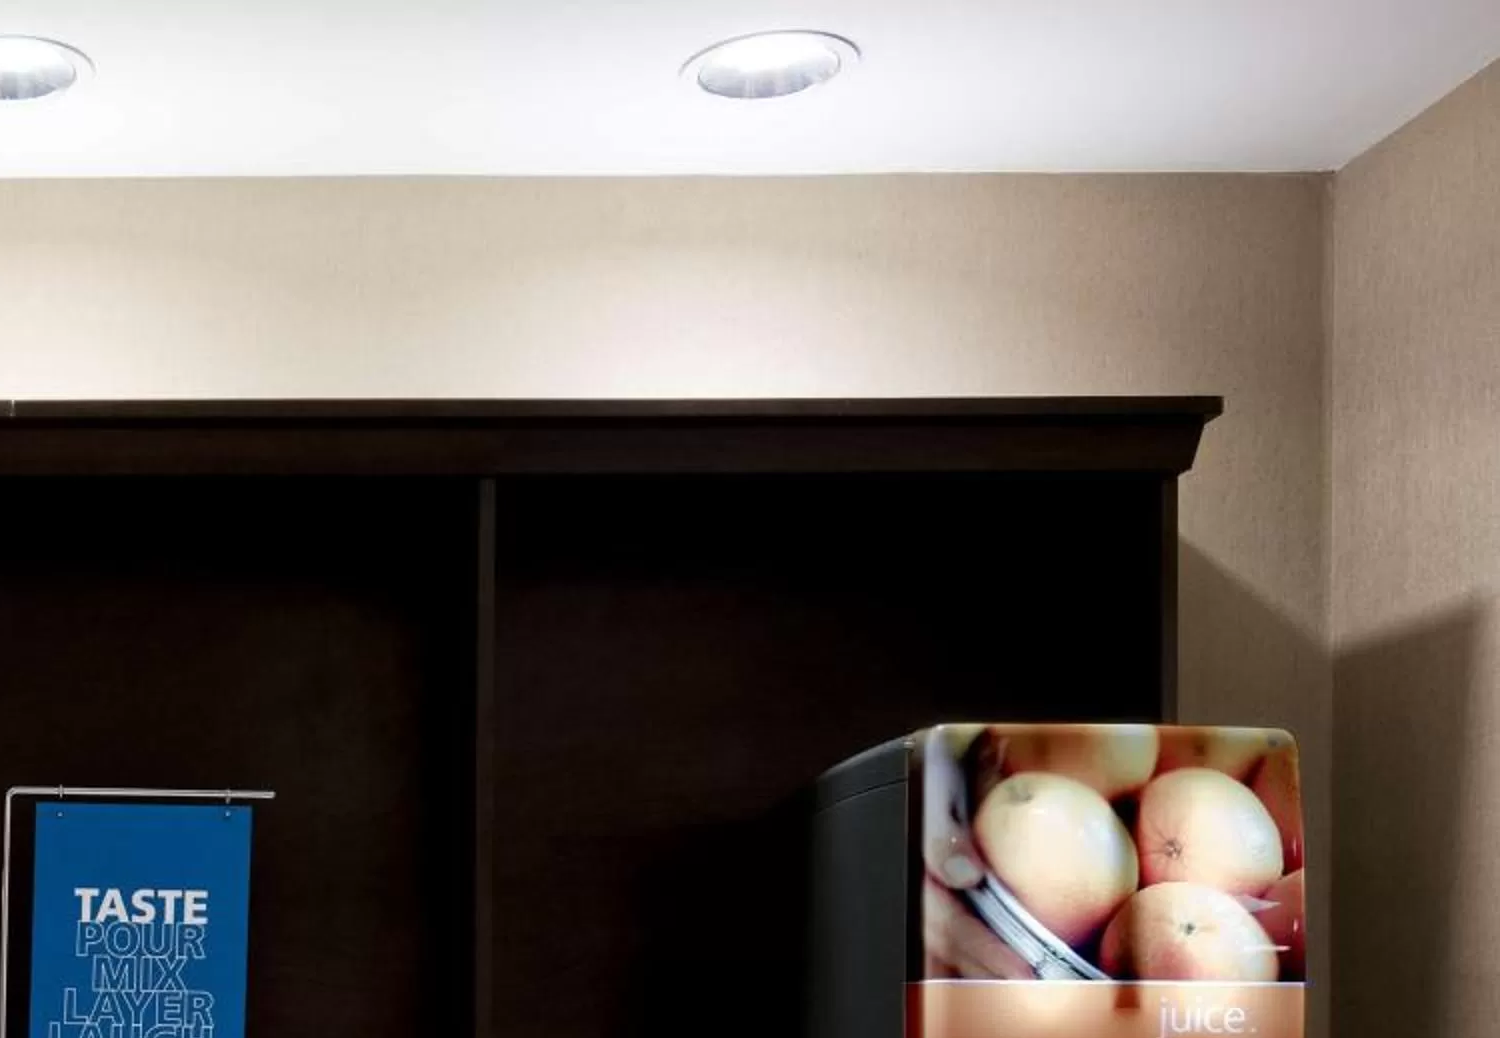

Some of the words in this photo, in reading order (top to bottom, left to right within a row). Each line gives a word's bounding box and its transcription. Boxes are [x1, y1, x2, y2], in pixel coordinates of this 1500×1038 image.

[74, 887, 208, 925] TASTE
[75, 919, 206, 959] POUR
[91, 953, 188, 993] MIX
[63, 987, 215, 1029] LAYER
